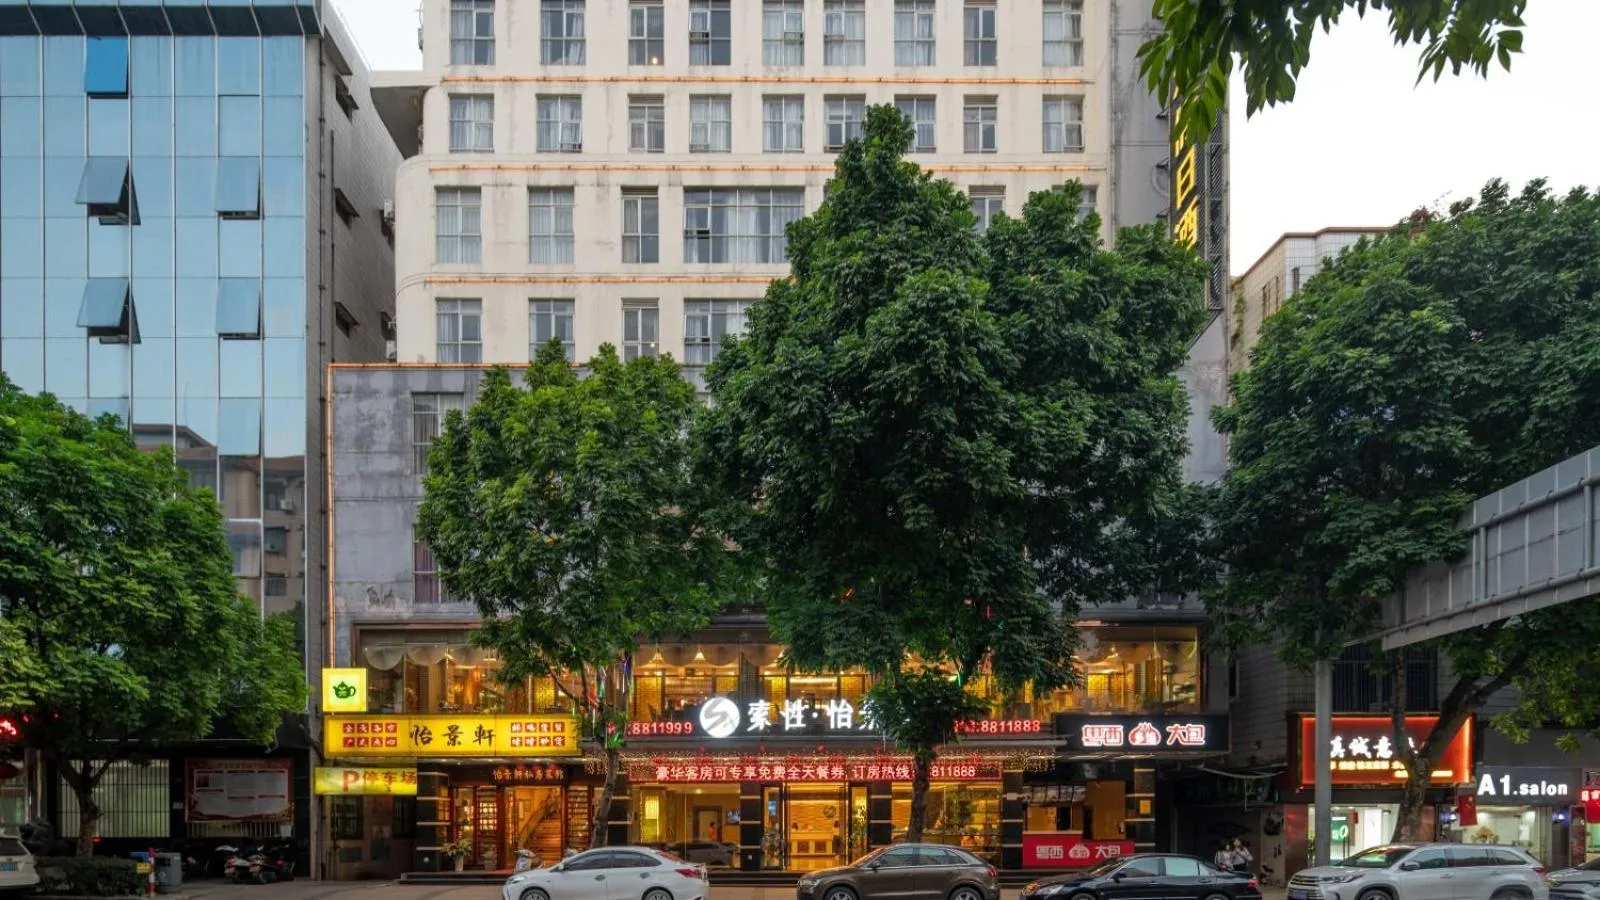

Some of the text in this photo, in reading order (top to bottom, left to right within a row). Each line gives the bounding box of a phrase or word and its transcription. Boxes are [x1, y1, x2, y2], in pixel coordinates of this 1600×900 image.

[1166, 723, 1206, 746] 大包
[343, 769, 417, 792] P 停车场
[1095, 844, 1121, 859] 大包
